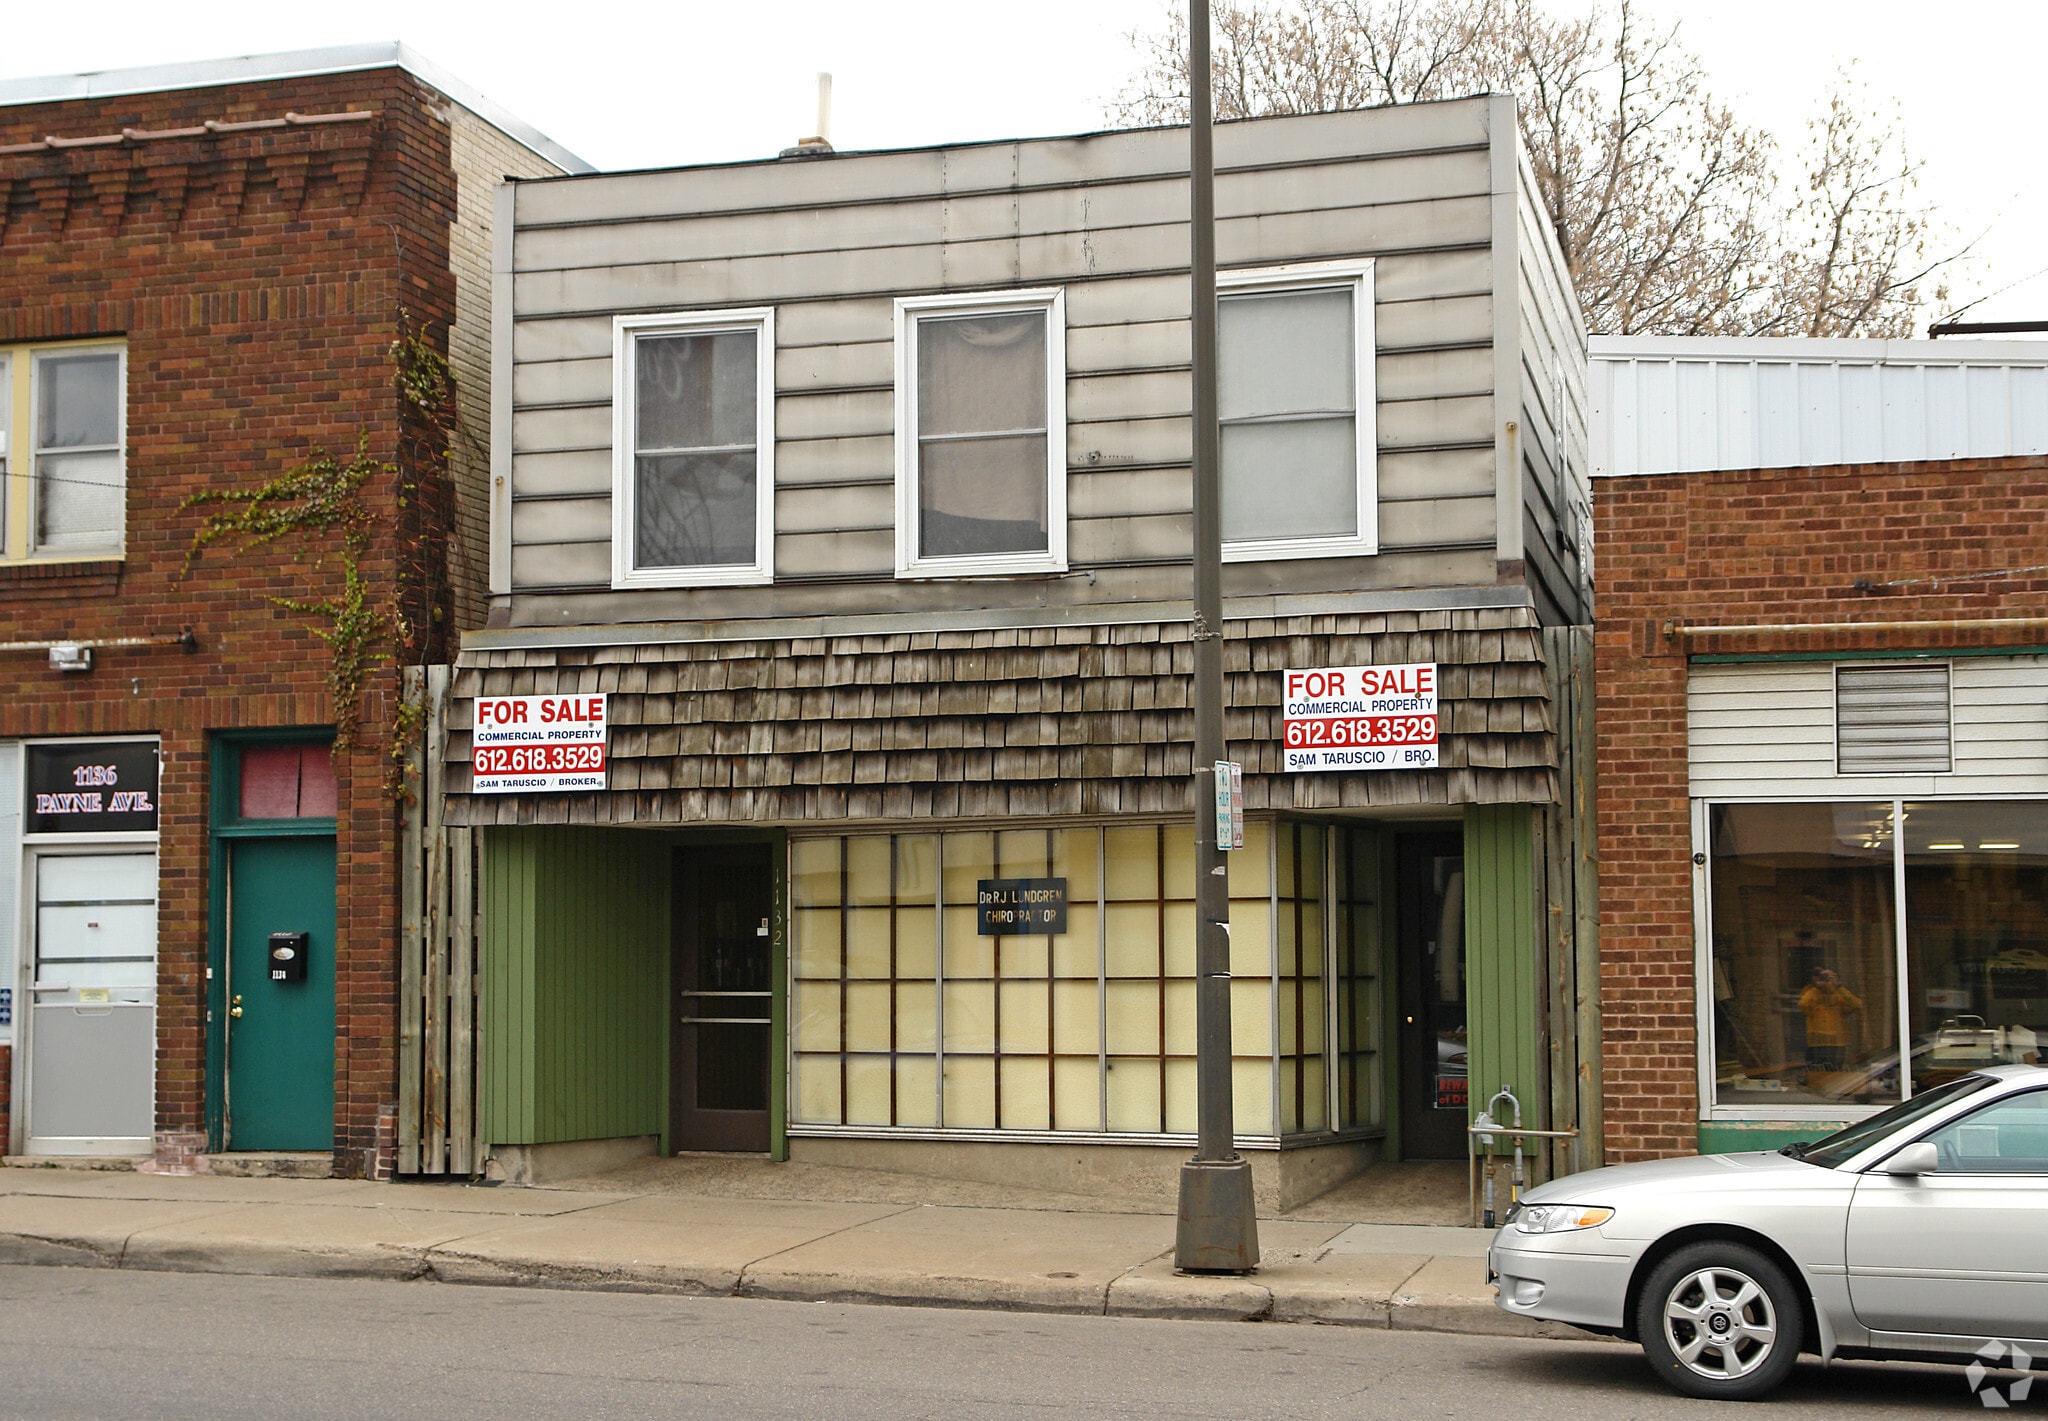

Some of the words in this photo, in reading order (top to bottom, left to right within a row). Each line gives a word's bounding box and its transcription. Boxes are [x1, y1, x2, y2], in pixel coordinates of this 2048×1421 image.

[1288, 672, 1345, 698] FOR
[1361, 668, 1433, 696] SALE
[478, 700, 528, 724] FOR
[540, 698, 603, 723] SALE
[1288, 701, 1366, 715] COMMERCIAL
[1372, 698, 1433, 712] PROPERTY
[478, 731, 544, 741] COMMERCIAL
[547, 730, 602, 739] PROPERTY
[1287, 716, 1436, 746] 612.618.3529
[475, 745, 602, 772] 612.618.3529
[1289, 753, 1316, 766] SAM
[1322, 751, 1385, 765] TARUSCIO
[1391, 749, 1398, 764] /
[1405, 749, 1435, 763] BRO.
[73, 764, 118, 786] 1136
[480, 780, 499, 788] SAM
[502, 779, 547, 787] TARUSCIO
[36, 792, 102, 814] PAYNE
[107, 791, 154, 812] AVE.
